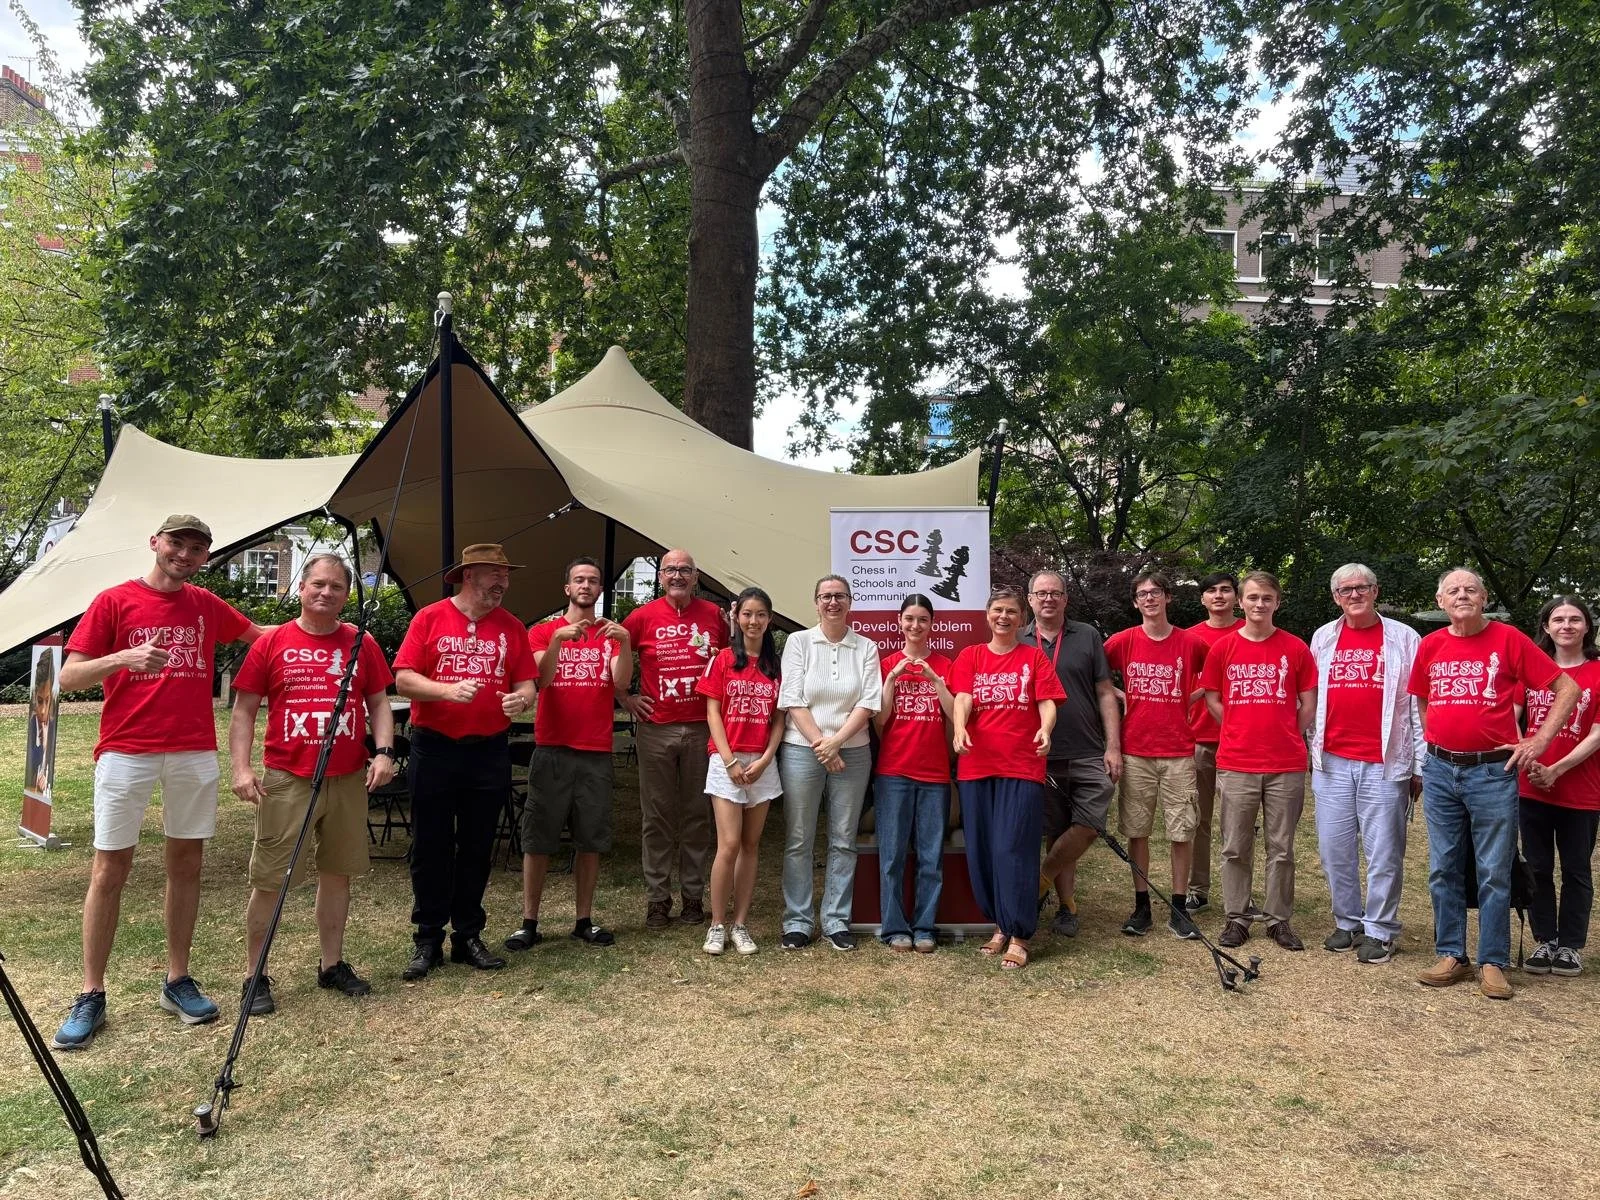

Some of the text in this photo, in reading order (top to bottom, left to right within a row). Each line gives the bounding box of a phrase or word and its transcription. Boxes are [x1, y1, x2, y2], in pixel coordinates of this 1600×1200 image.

[850, 529, 920, 554] CSC
[852, 566, 898, 575] Chess in
[852, 578, 916, 588] Schools and
[655, 623, 689, 640] CSC
[931, 620, 972, 632] oblem
[437, 635, 496, 654] CHESS
[925, 637, 954, 650] kills
[167, 645, 198, 668] ST
[283, 648, 328, 663] CSC
[558, 647, 600, 662] HESS
[1332, 648, 1375, 663] HESS
[436, 653, 496, 675] FEST
[1127, 661, 1174, 679] CHESS
[1226, 663, 1277, 681] CHESS
[283, 675, 311, 684] Schools
[1127, 677, 1172, 696] FEST
[727, 680, 773, 698] CHESS
[1228, 679, 1277, 699] FEST
[728, 696, 772, 716] FEST
